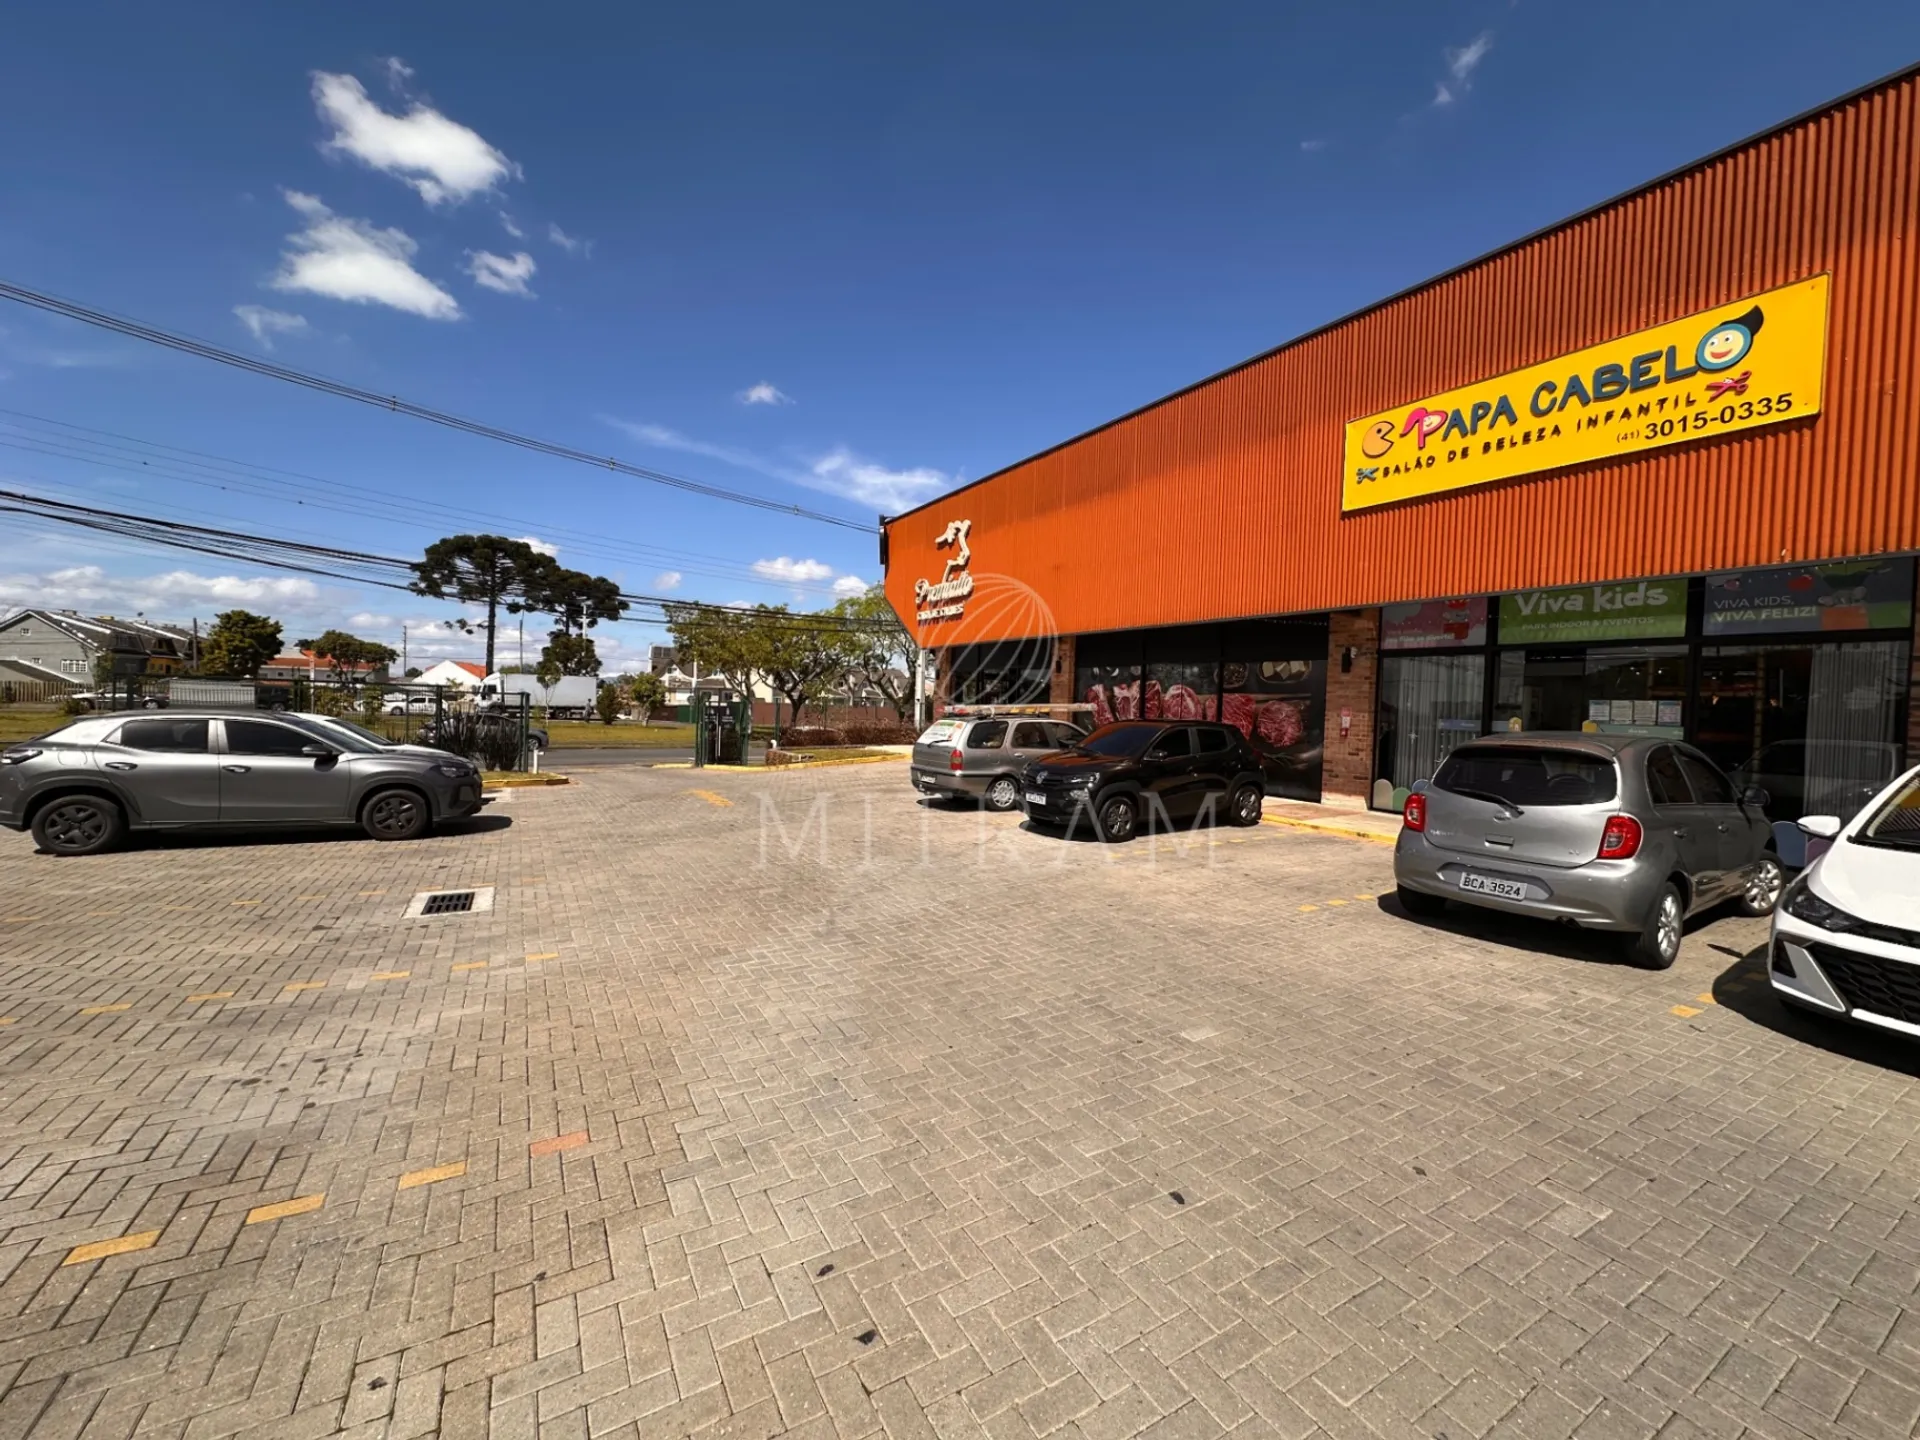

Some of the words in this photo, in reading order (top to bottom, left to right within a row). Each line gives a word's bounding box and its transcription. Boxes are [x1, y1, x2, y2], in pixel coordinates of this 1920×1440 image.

[1400, 394, 1518, 450] PAPA
[1530, 316, 1757, 418] CABELO
[1447, 446, 1470, 464] DE
[1482, 424, 1562, 456] BELEZA
[1576, 392, 1697, 432] INFANTIL
[1616, 430, 1640, 444] (41)
[1644, 392, 1793, 441] 3015-0335
[1514, 591, 1583, 616] Viva
[1593, 582, 1669, 613] kids
[1713, 610, 1756, 622] VIVA
[1761, 605, 1817, 619] FELIZ!
[1714, 598, 1750, 609] VIVA
[1603, 616, 1656, 627] EVENTOS
